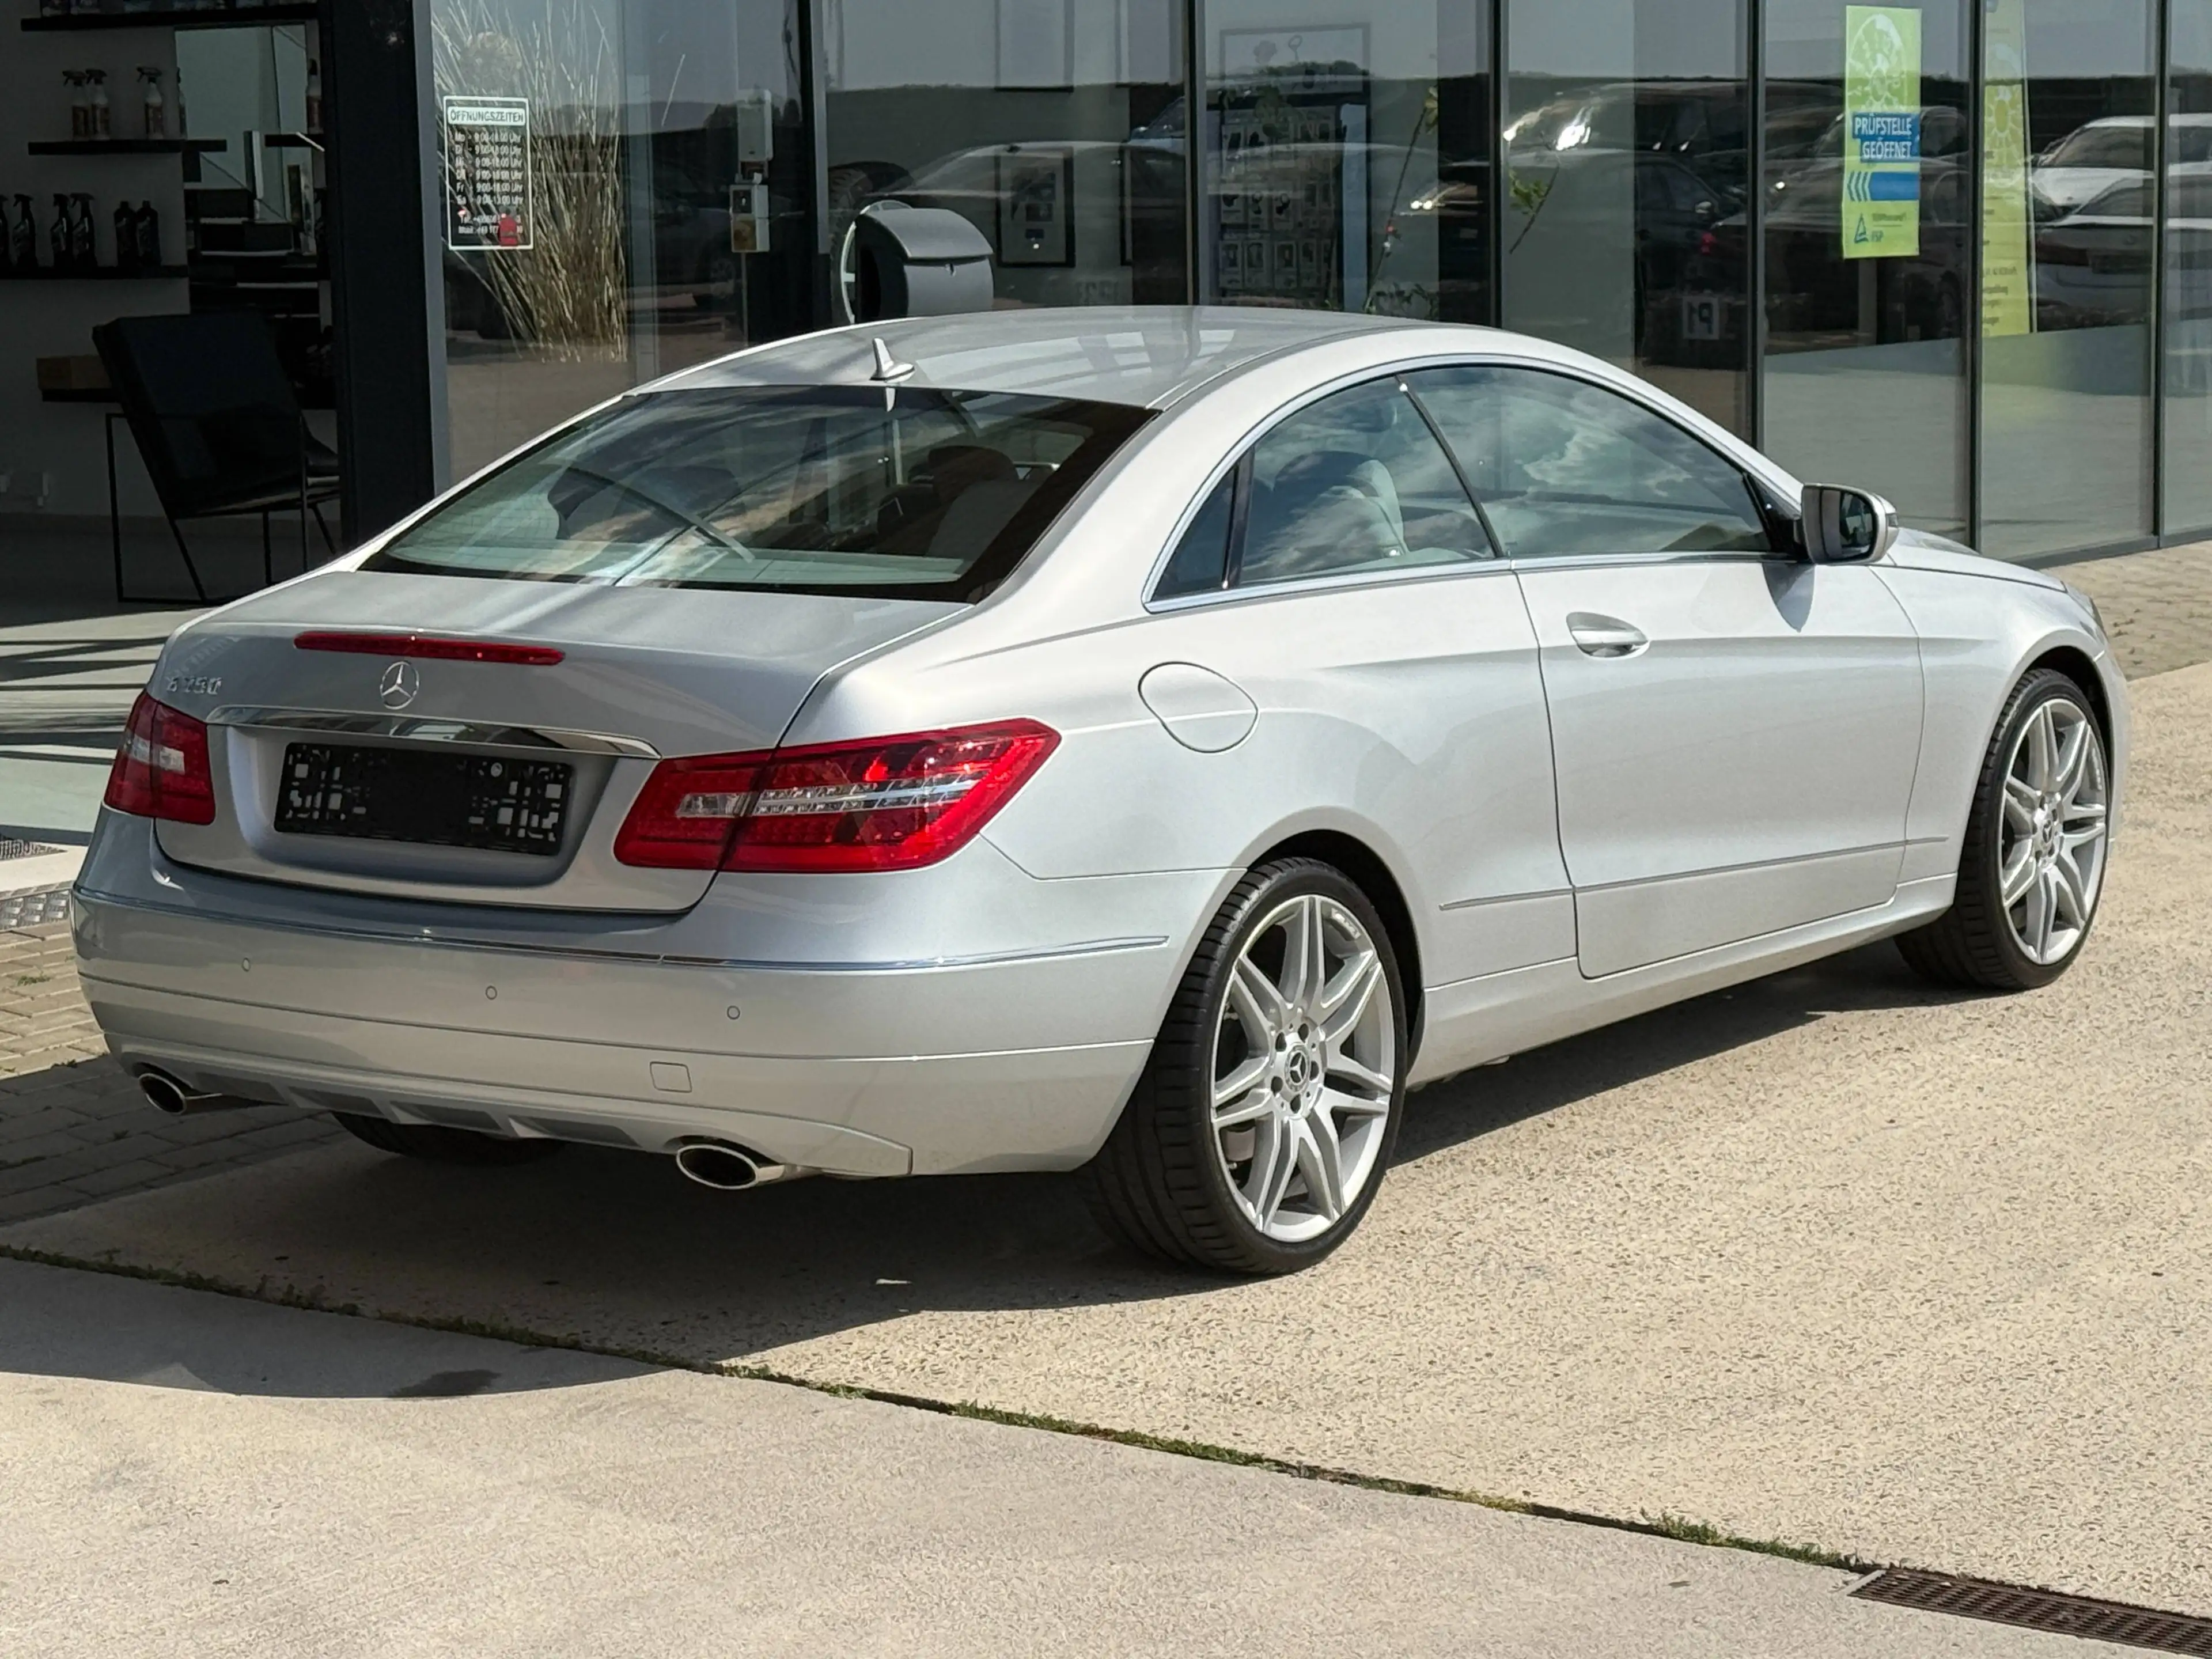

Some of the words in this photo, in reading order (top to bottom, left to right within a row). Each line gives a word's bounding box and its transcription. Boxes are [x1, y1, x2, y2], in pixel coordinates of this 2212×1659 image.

[450, 109, 524, 123] ÖFFNUNGSZEITEN
[1854, 112, 1912, 135] PRÜFSTELLE
[1862, 137, 1912, 159] GEÖFFNET
